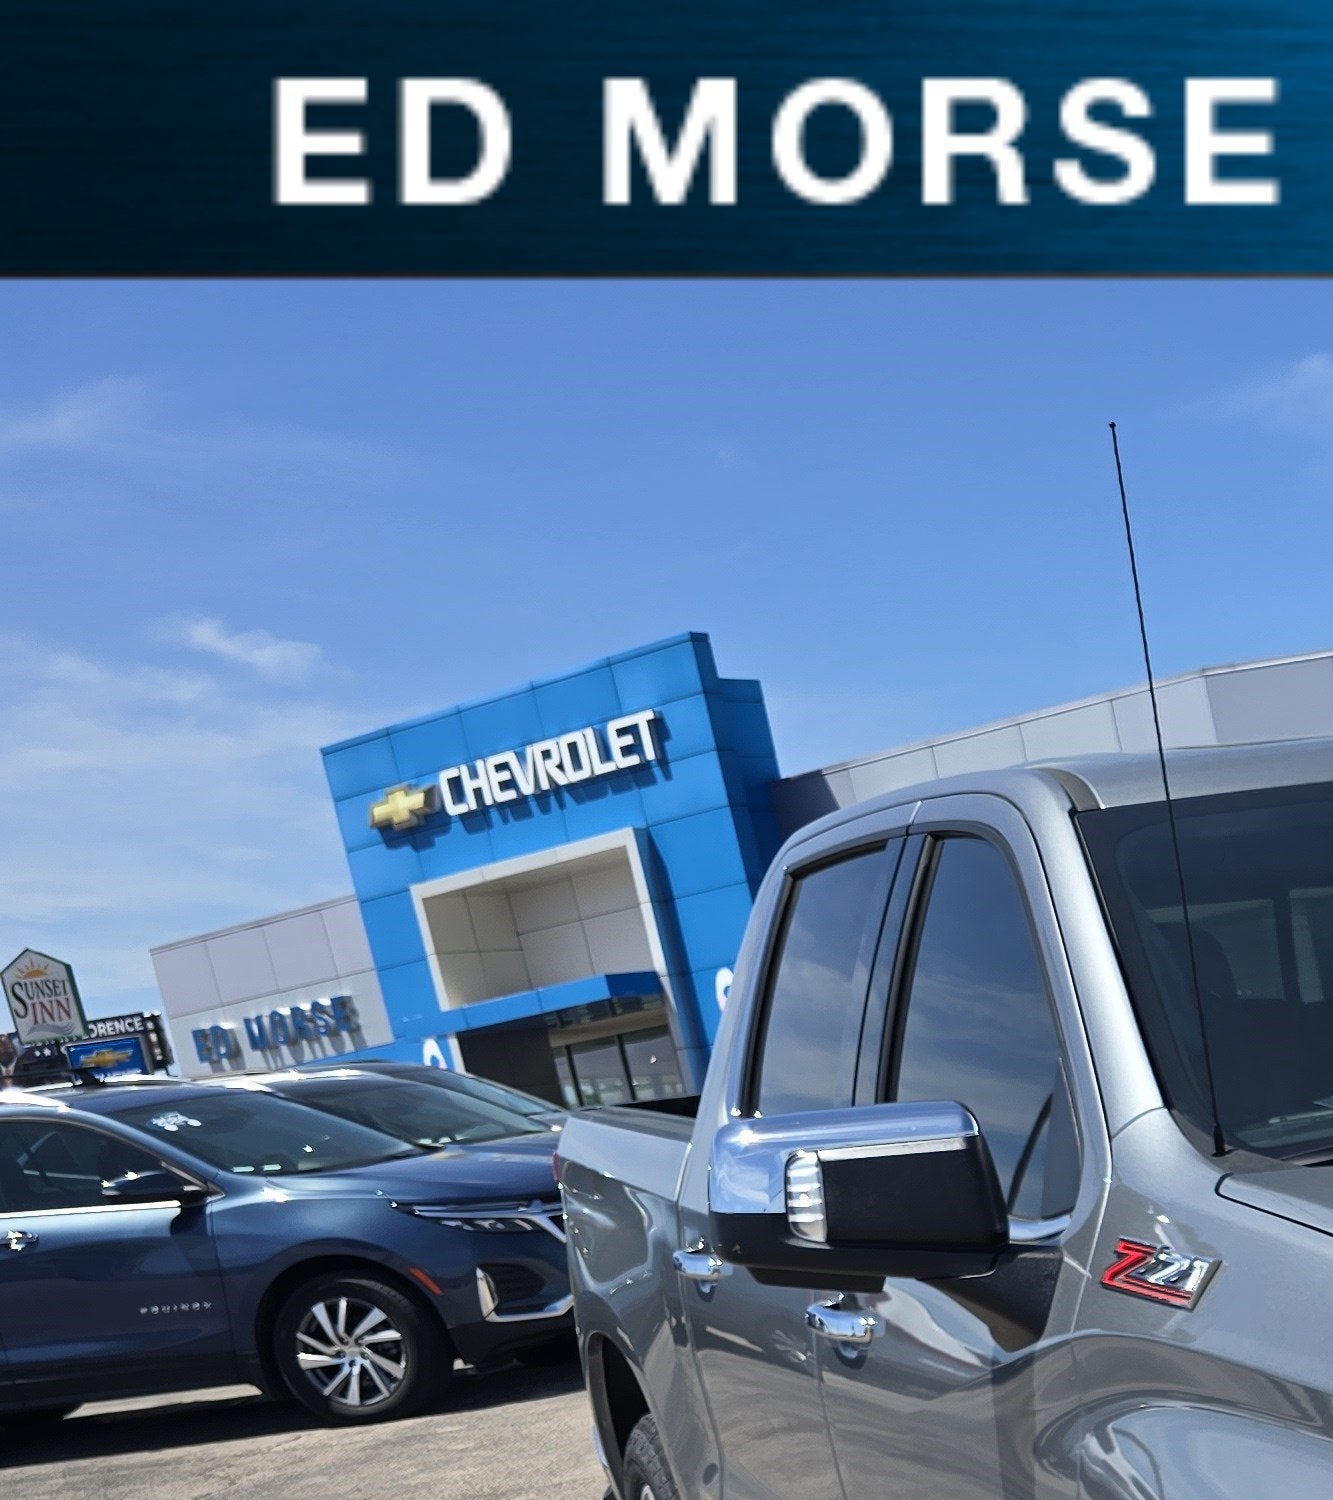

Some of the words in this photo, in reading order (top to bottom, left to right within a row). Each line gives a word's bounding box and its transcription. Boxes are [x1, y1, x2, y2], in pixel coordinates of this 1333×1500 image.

[438, 708, 657, 817] CHEVROLET
[11, 979, 68, 1020] SUNSET
[30, 997, 72, 1026] INN
[191, 1025, 238, 1064] ED
[243, 995, 358, 1052] MORSE
[1101, 1239, 1218, 1310] Z71
